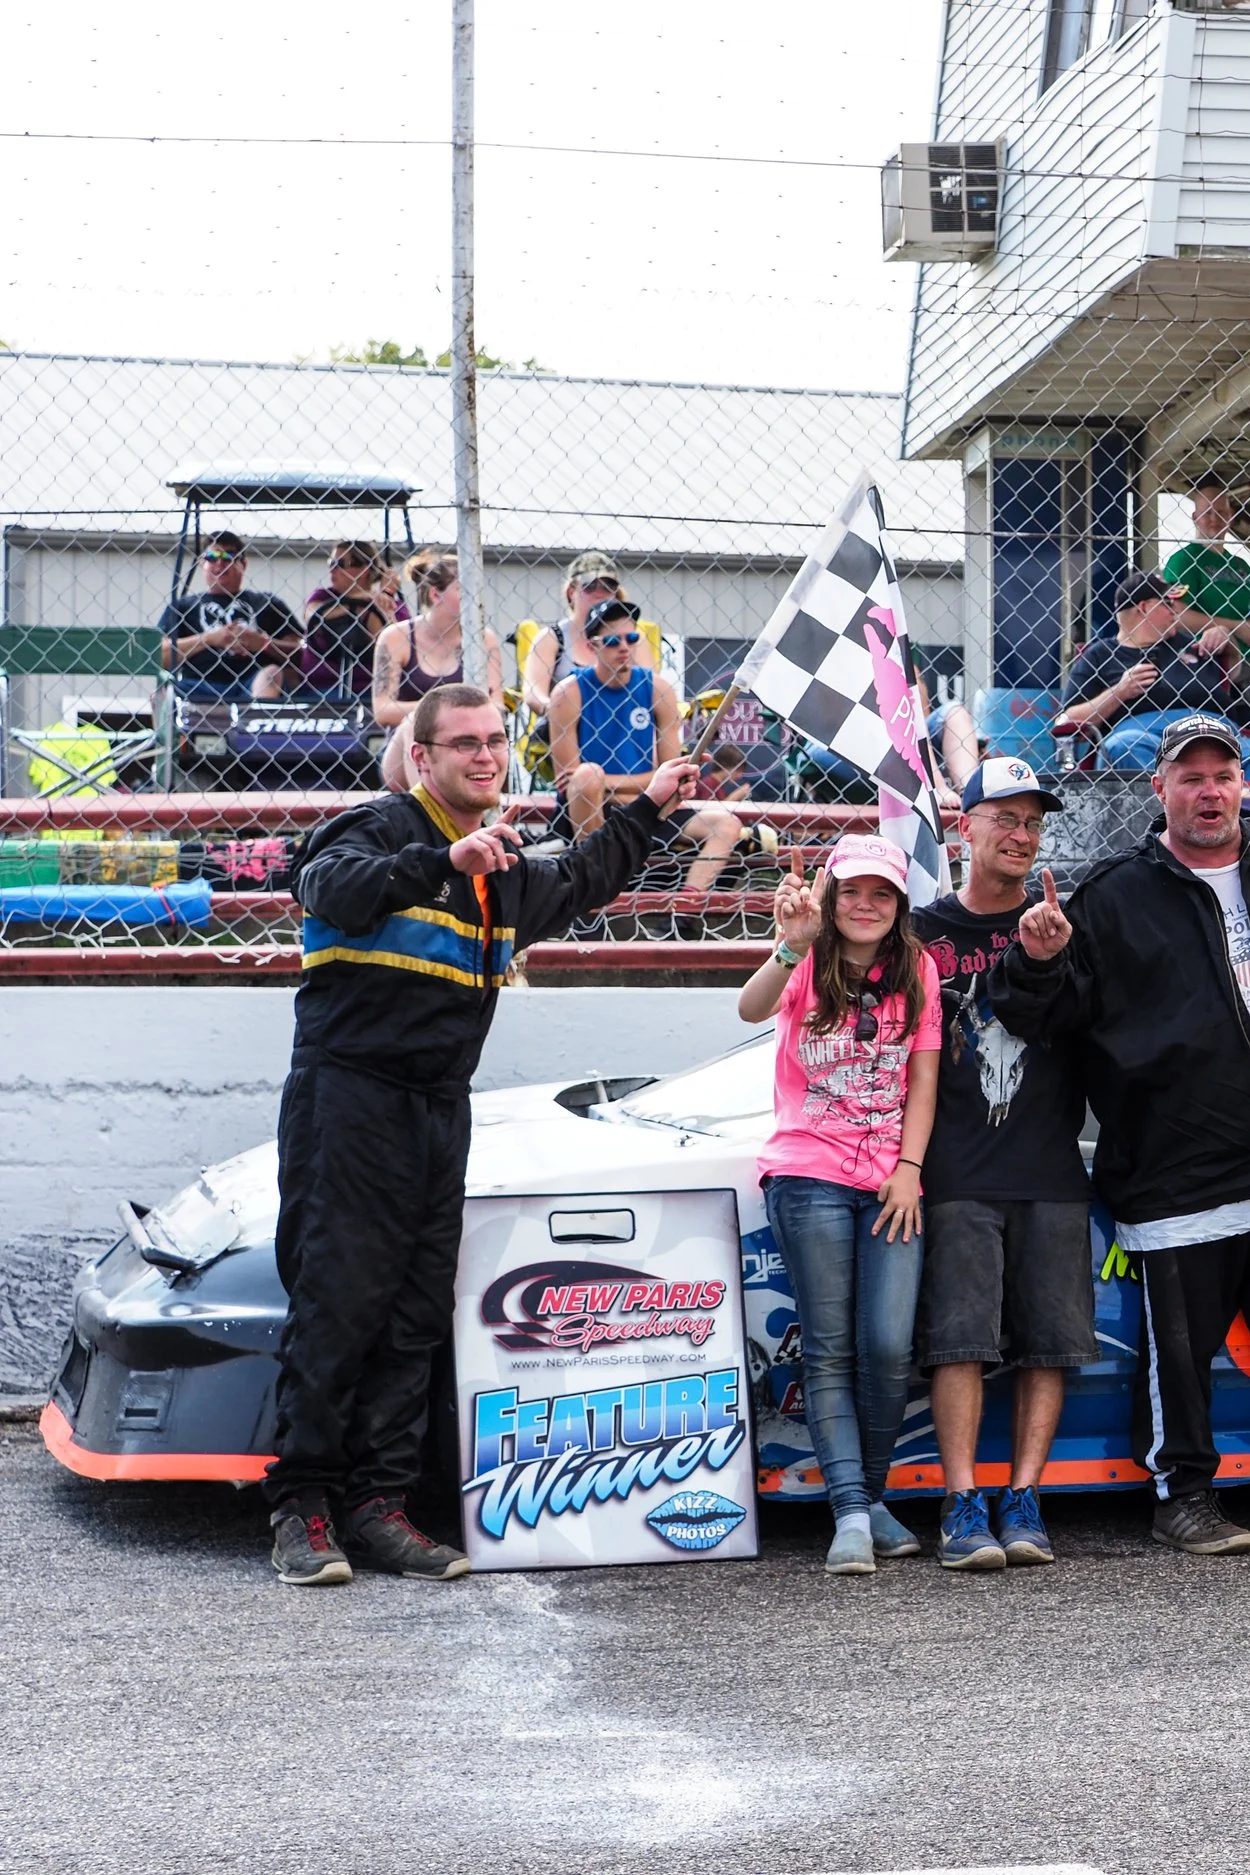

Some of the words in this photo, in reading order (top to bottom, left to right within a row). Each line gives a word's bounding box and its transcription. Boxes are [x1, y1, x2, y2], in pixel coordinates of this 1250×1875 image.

[536, 1283, 623, 1315] NEW
[622, 1279, 726, 1311] PARIS
[550, 1313, 715, 1353] Speedway
[473, 1368, 740, 1479] FEATURE
[461, 1420, 745, 1540] Winner
[673, 1494, 717, 1511] KIZZ
[665, 1523, 728, 1540] PHOTOS
